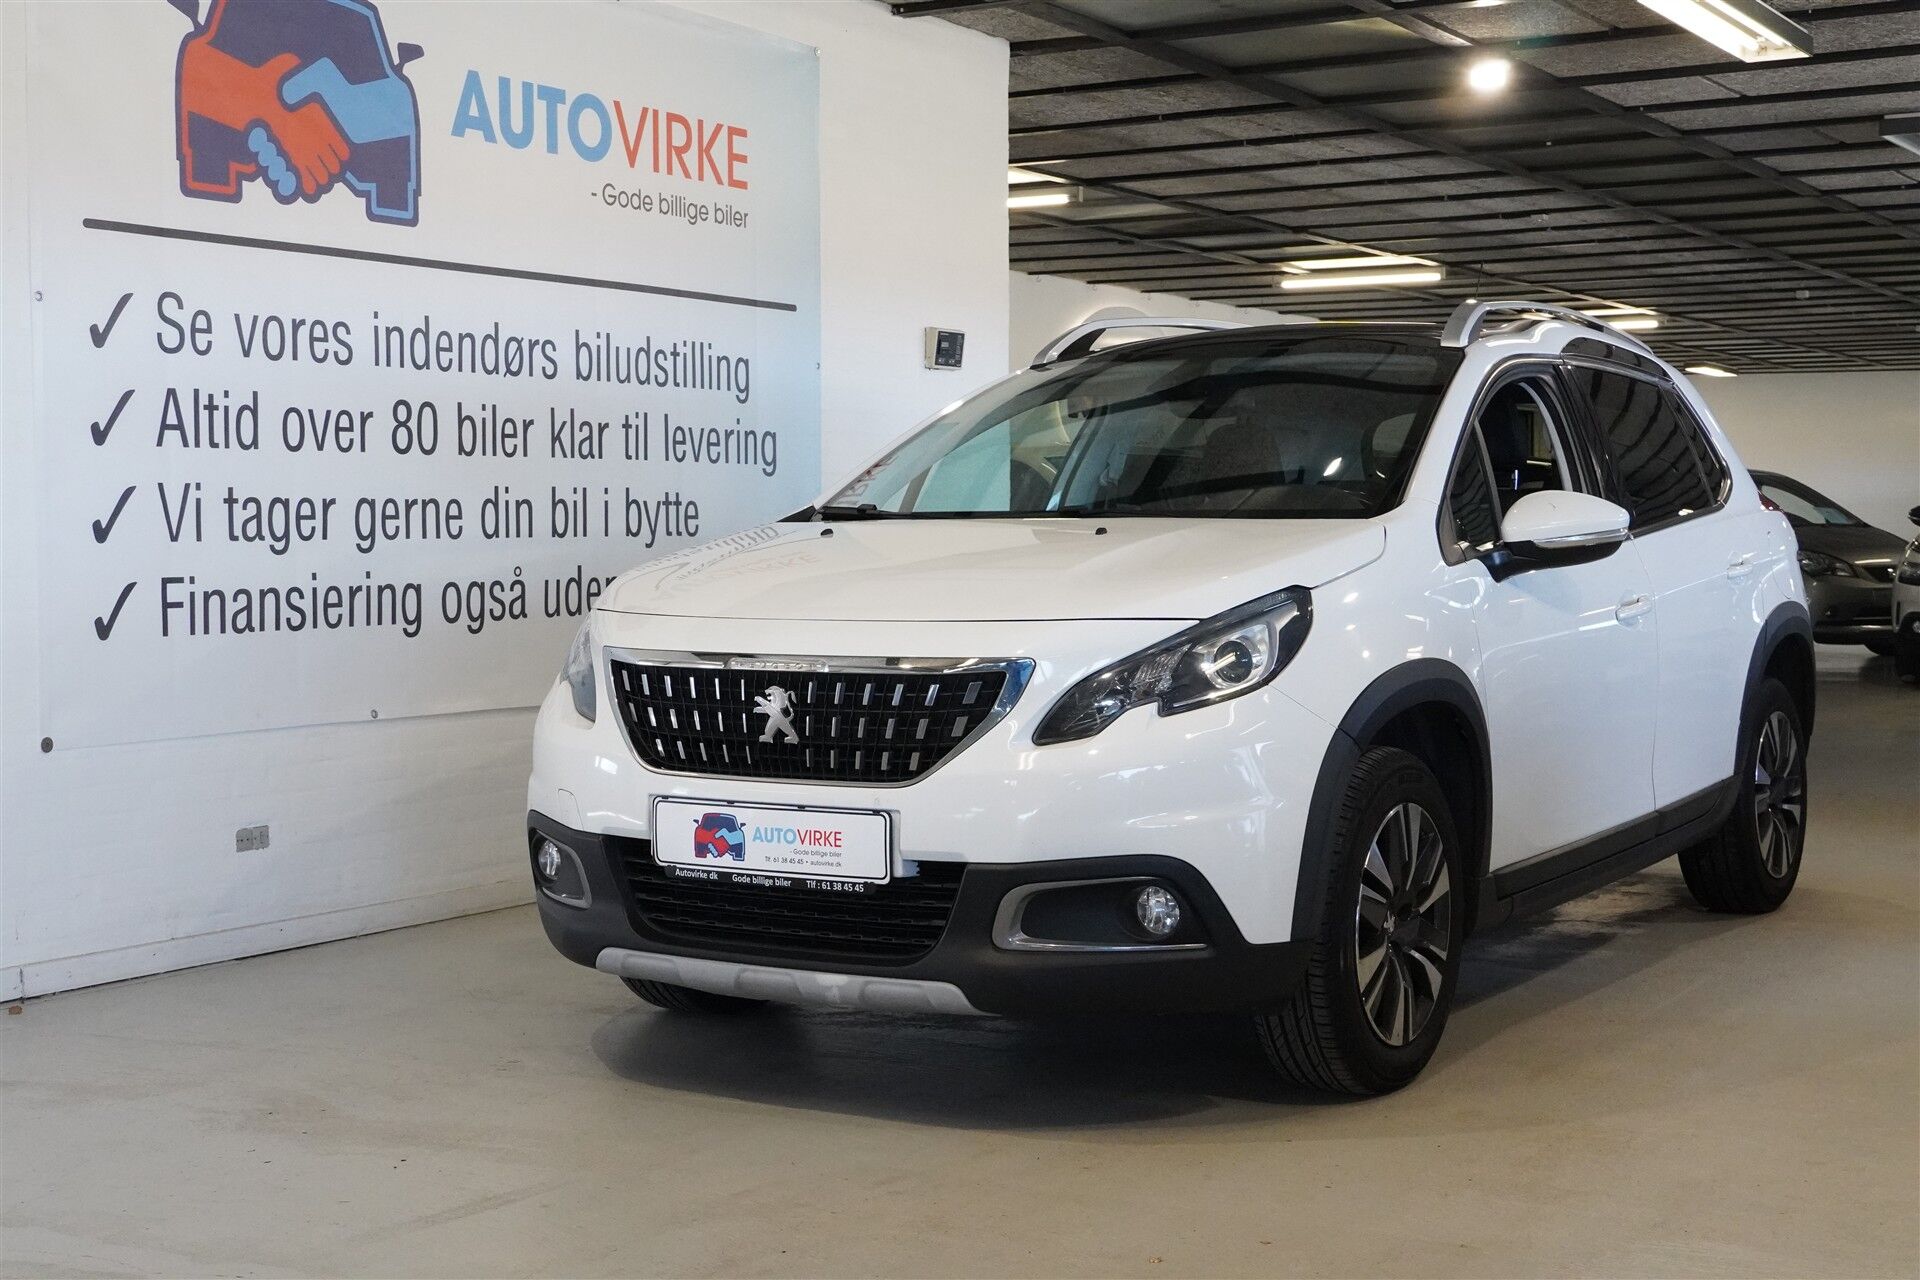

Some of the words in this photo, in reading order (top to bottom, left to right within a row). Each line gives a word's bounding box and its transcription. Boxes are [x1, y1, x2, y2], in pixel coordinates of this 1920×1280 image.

[451, 69, 748, 190] AUTOVIRKE
[602, 183, 653, 213] Gode
[658, 192, 709, 226] billige
[714, 203, 749, 228] biler
[156, 291, 213, 357] Se
[234, 313, 354, 366] vores
[373, 310, 558, 380] indendørs
[575, 329, 750, 405] biludstilling
[156, 387, 259, 451] Altid
[282, 406, 374, 454] over
[391, 398, 439, 456] 80
[456, 401, 535, 459] biler
[550, 406, 610, 461] klar
[621, 411, 649, 461] til
[663, 413, 777, 478] levering
[157, 482, 203, 543] Vi
[222, 486, 337, 556] tager
[354, 497, 464, 555] gerne
[480, 485, 534, 540] din
[551, 485, 588, 539] bil
[603, 487, 609, 538] i
[625, 486, 700, 549] bytte
[160, 570, 423, 639] Finansiering
[441, 565, 529, 635] også
[543, 564, 618, 619] ude
[752, 826, 842, 848] AUTOVIRKE
[793, 848, 810, 856] Gode
[732, 874, 751, 884] Gode
[752, 876, 773, 887] billige
[775, 878, 792, 887] biler
[821, 881, 831, 890] 61
[832, 883, 842, 892] 38
[843, 883, 853, 892] 45
[854, 884, 864, 893] 45
